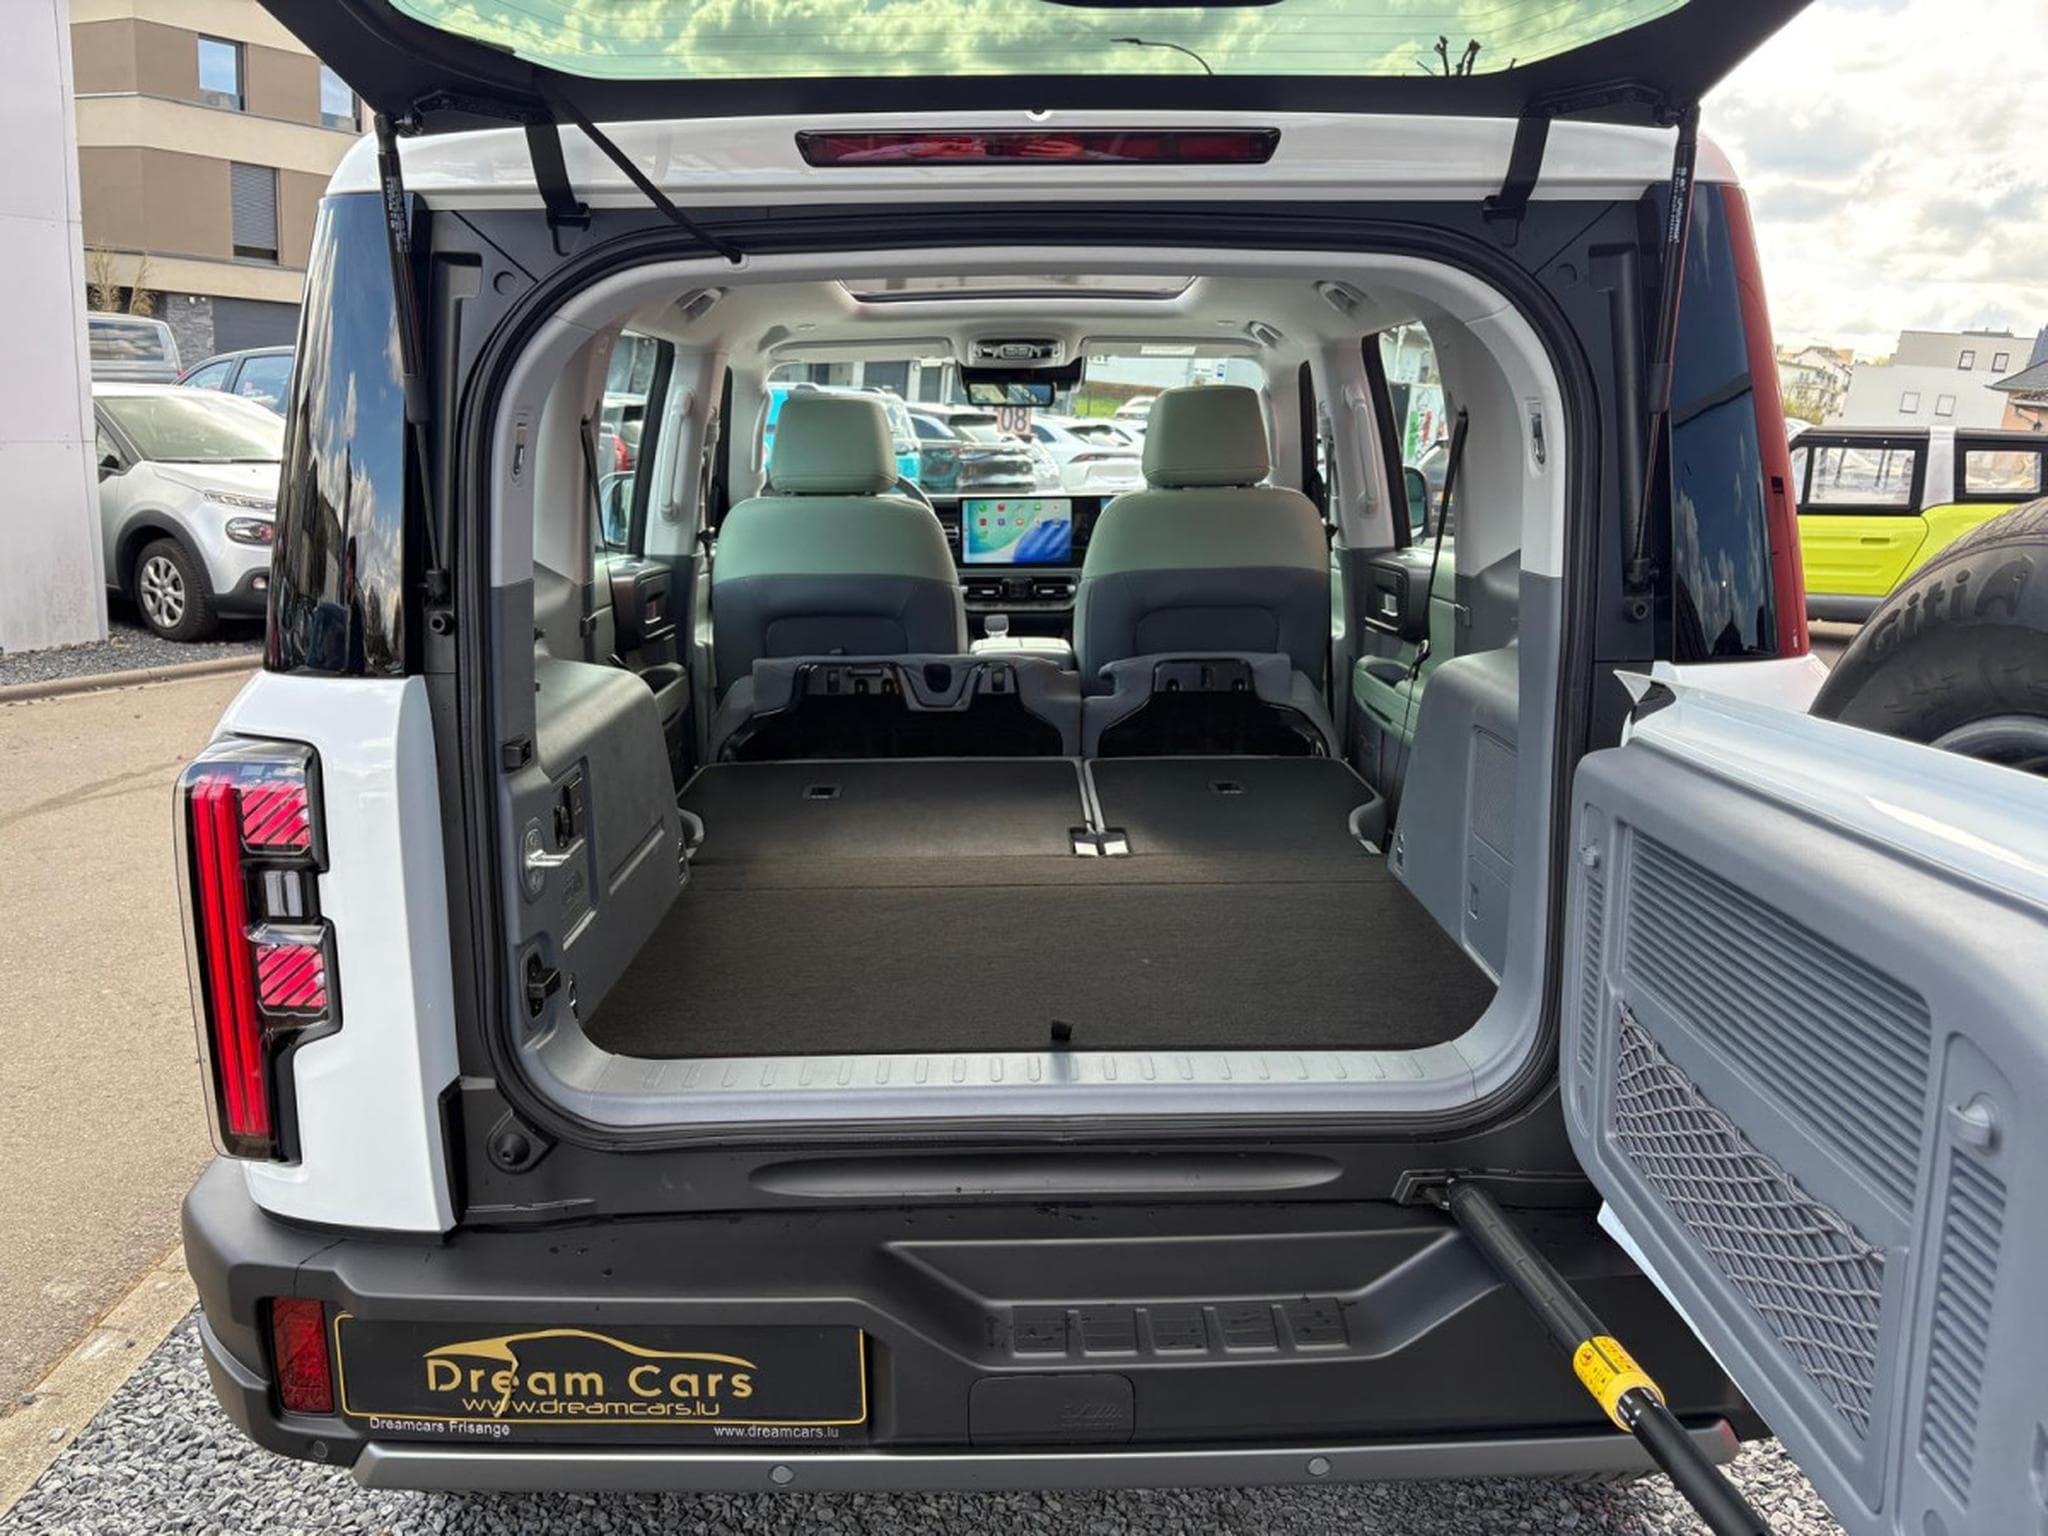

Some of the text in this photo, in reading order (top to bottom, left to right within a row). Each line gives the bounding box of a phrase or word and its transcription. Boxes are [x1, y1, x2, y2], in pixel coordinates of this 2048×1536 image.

[426, 1358, 753, 1398] Dream Cars
[462, 1398, 720, 1417] www.dreamcars.lu
[369, 1417, 511, 1438] Dreamcars Frisange
[713, 1425, 840, 1438] www.dreamcars.lu
